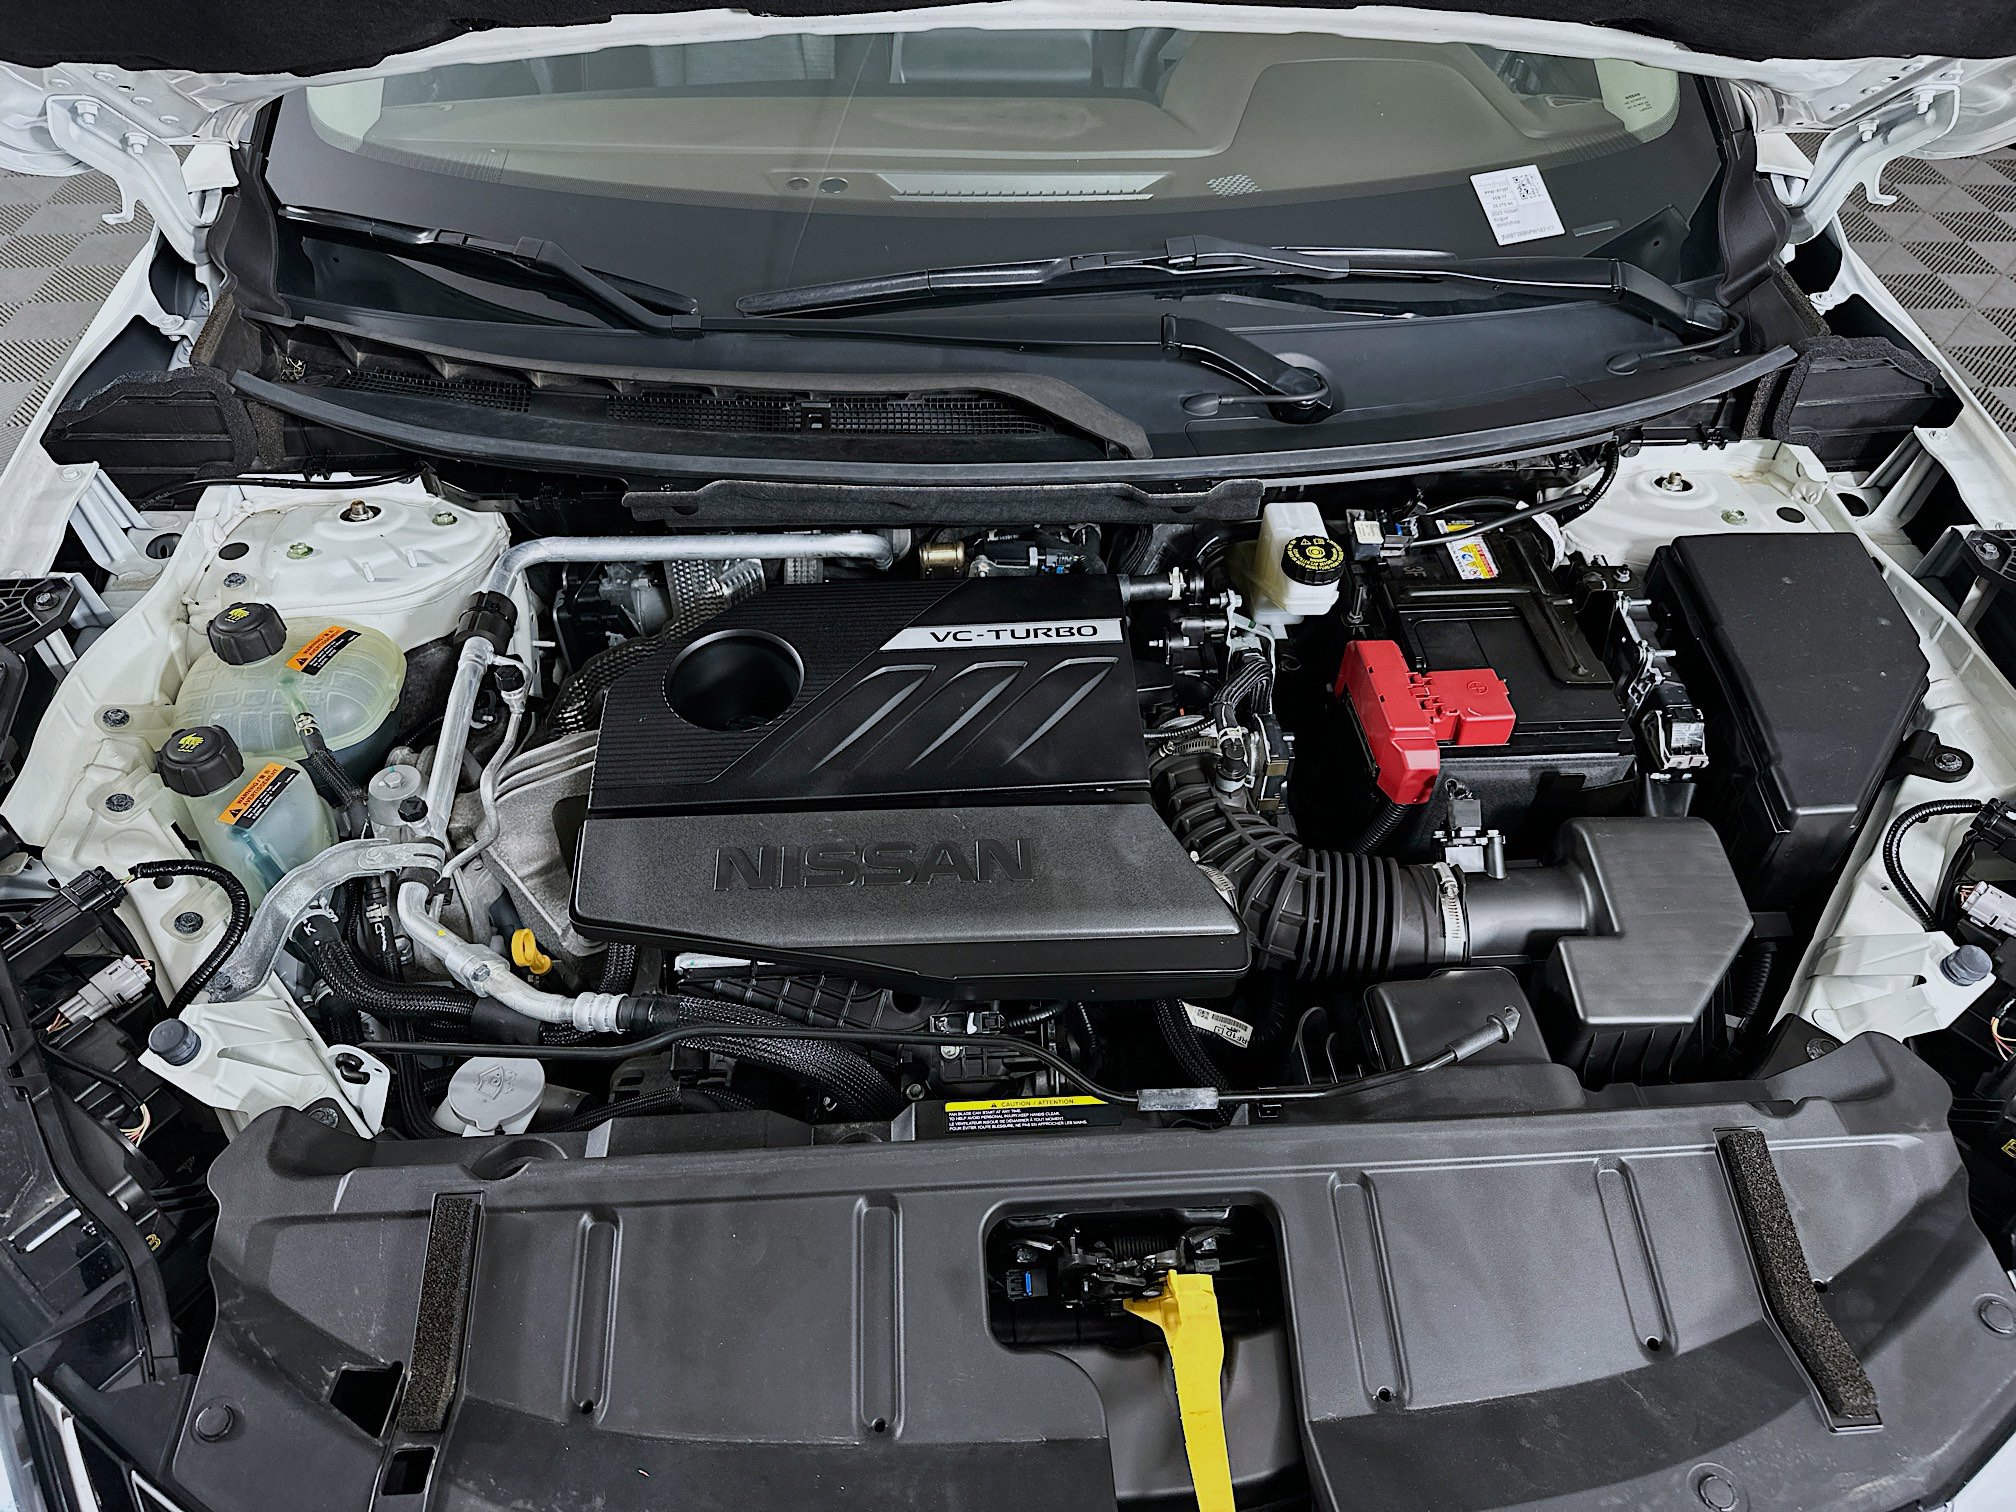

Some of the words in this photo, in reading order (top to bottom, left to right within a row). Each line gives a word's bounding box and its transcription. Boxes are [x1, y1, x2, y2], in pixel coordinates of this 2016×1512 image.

[930, 625, 1098, 643] VC-TURBO
[237, 780, 259, 805] WARNING
[714, 838, 1034, 891] NISSAN
